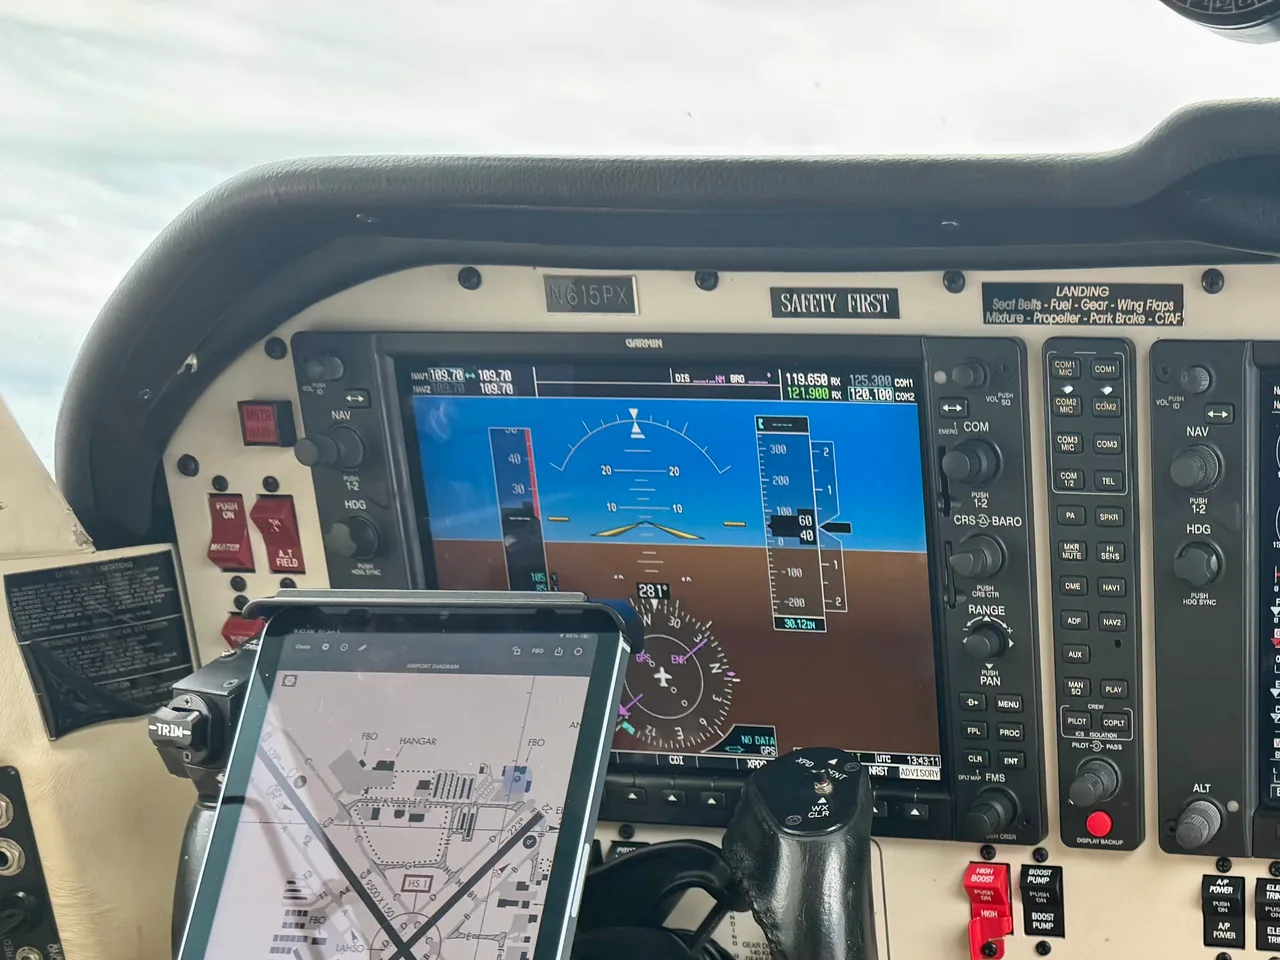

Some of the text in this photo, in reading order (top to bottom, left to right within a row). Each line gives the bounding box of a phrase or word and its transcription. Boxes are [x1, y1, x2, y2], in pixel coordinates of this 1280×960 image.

[549, 284, 630, 305] N615PX
[1056, 286, 1110, 297] LANDING
[780, 293, 890, 314] SAFETY FIRST
[992, 299, 1174, 313] Seat Belts Fuel Gear Wing Flaps
[985, 312, 1181, 325] Mixture Propeller Park Brake CTAF
[625, 338, 662, 348] GARMIN
[1055, 361, 1075, 369] COM1
[1095, 365, 1115, 373] COM1
[430, 370, 511, 382] 109.70 109.70
[786, 373, 828, 386] 119.650
[831, 376, 841, 386] RX
[895, 377, 913, 387] COM1
[787, 388, 915, 401] 121.900 RX 120.100 COM2
[1095, 402, 1116, 411] COM2
[963, 422, 989, 432] COM
[1186, 427, 1209, 437] NAV
[1102, 477, 1115, 485] TEL
[954, 516, 1022, 527] CRS BARO
[1100, 513, 1118, 521] SPKR
[1187, 524, 1211, 534] HDG
[638, 584, 668, 598] 281°
[968, 605, 1005, 615] RANGE
[1103, 618, 1121, 626] NAV2
[980, 676, 1001, 686] PAN
[1106, 685, 1122, 693] PLAY
[998, 700, 1019, 709] MENU
[1068, 717, 1086, 725] PILOT
[1103, 719, 1125, 727] COPLT
[157, 723, 183, 737] TRIM
[1000, 729, 1020, 737] PROC
[399, 737, 437, 746] HANGAR
[528, 738, 545, 747] FBO
[741, 735, 775, 745] NO DATA
[906, 756, 940, 766] 13:43:11
[869, 766, 888, 776] NRST
[900, 767, 940, 779] ADVISORY
[985, 773, 1005, 783] FMS
[1193, 783, 1211, 793] ALT
[408, 880, 420, 888] HS
[1027, 876, 1049, 884] PUMP
[1209, 886, 1233, 894] POWER
[336, 944, 364, 953] LAHSO
